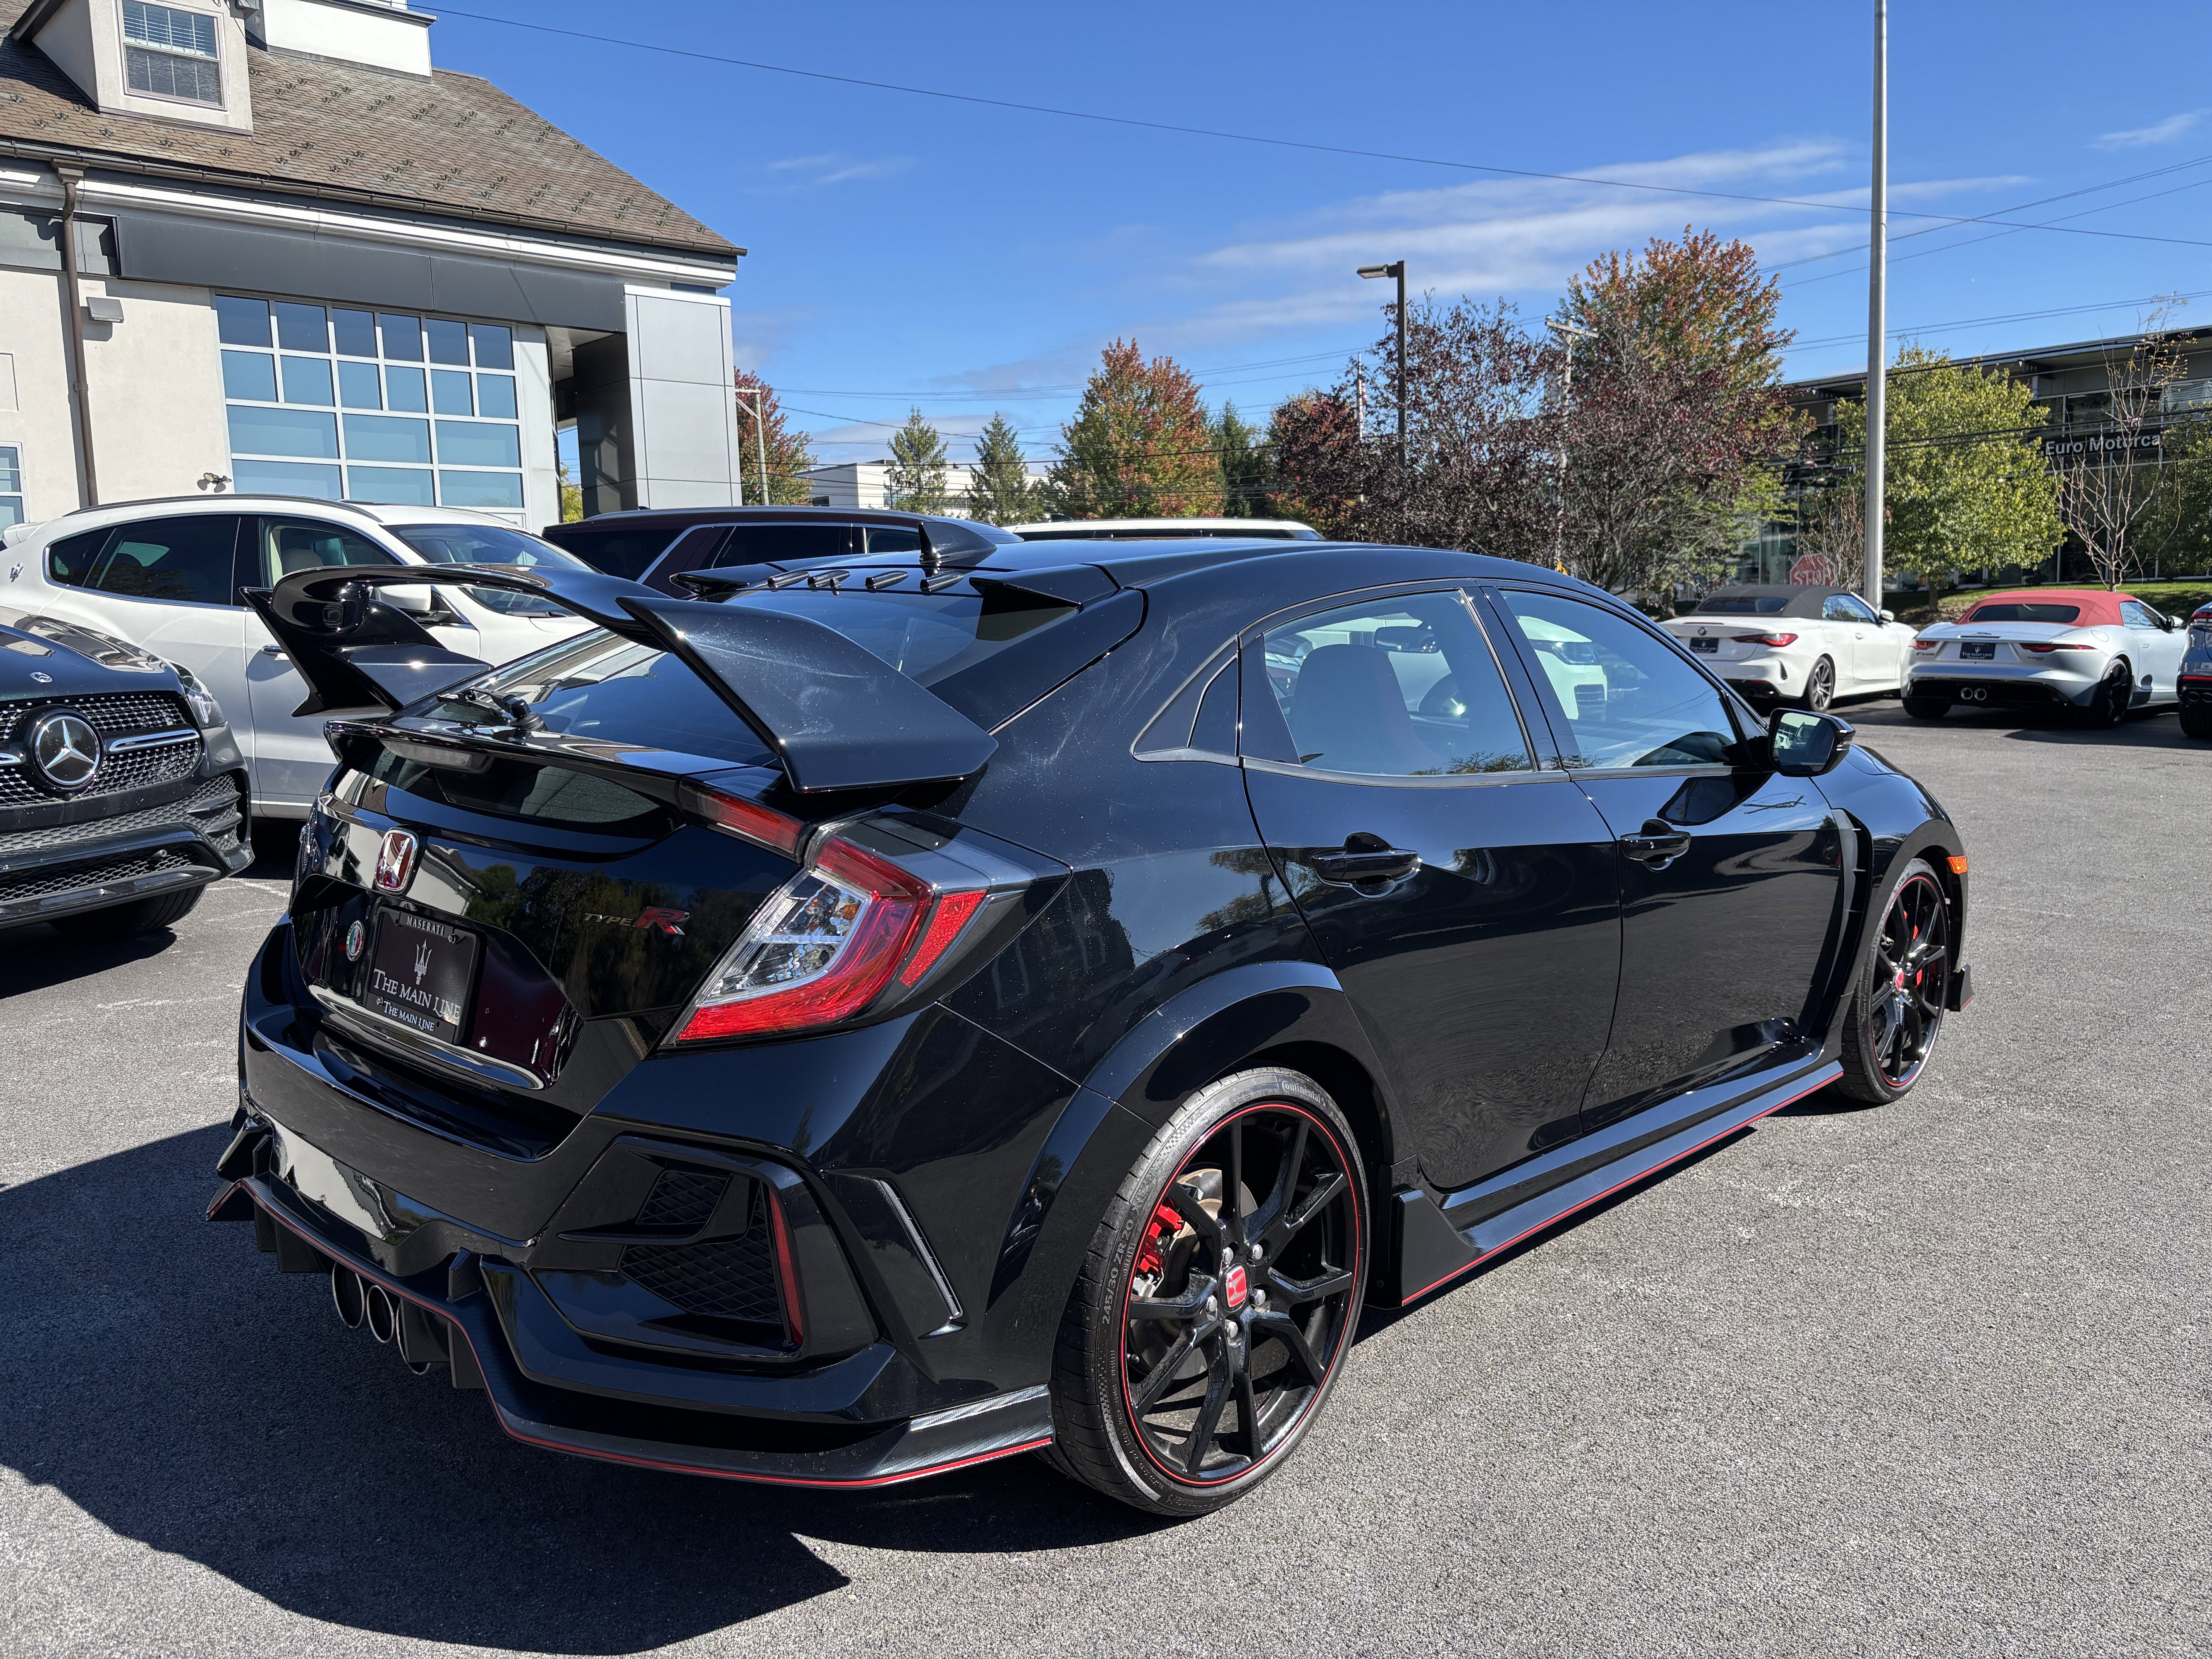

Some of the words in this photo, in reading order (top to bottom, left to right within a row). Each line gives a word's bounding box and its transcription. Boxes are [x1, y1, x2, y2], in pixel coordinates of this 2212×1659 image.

[2045, 441, 2083, 455] Euro
[407, 916, 445, 935] MASERATI
[584, 913, 634, 926] TYPE
[633, 906, 690, 935] R
[374, 968, 398, 995] THE
[399, 984, 432, 1008] MAIN
[433, 996, 461, 1019] LINE
[384, 1000, 398, 1017] THE
[399, 1010, 418, 1025] MAIN
[418, 1018, 435, 1031] LINE
[1281, 1080, 1321, 1104] Continental
[1123, 1242, 1136, 1274] OUTSIDE
[1102, 1267, 1119, 1325] 245/30
